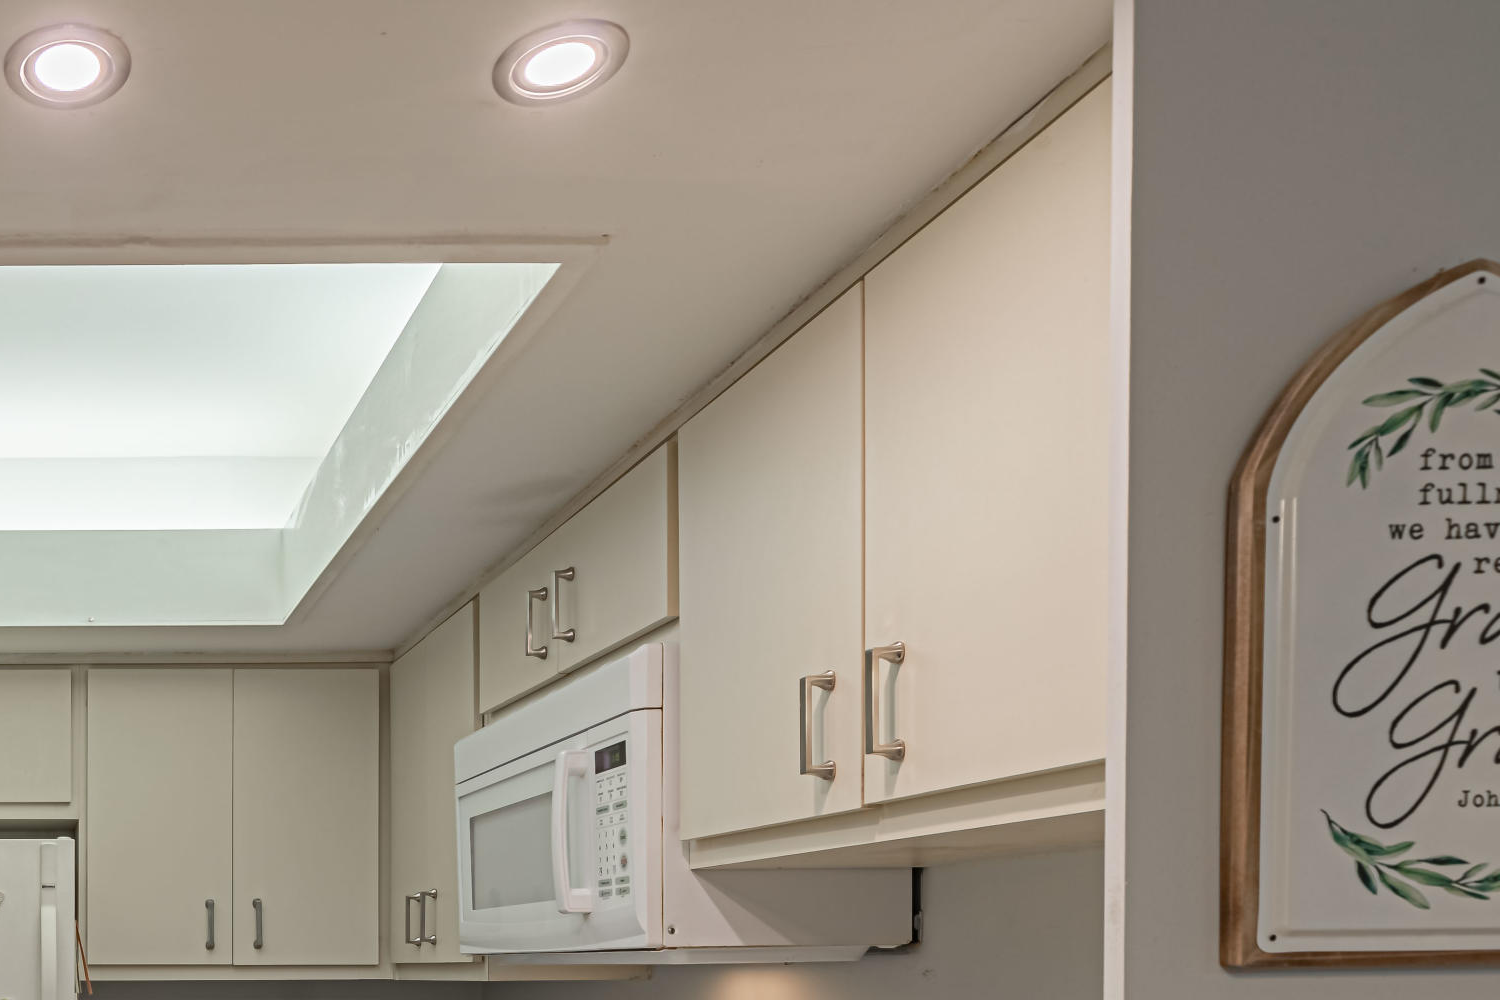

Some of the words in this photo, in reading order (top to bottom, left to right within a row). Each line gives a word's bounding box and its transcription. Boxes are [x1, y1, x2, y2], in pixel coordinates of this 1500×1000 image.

[1419, 447, 1495, 471] from
[1388, 522, 1424, 540] we
[1365, 679, 1500, 830] Gr
